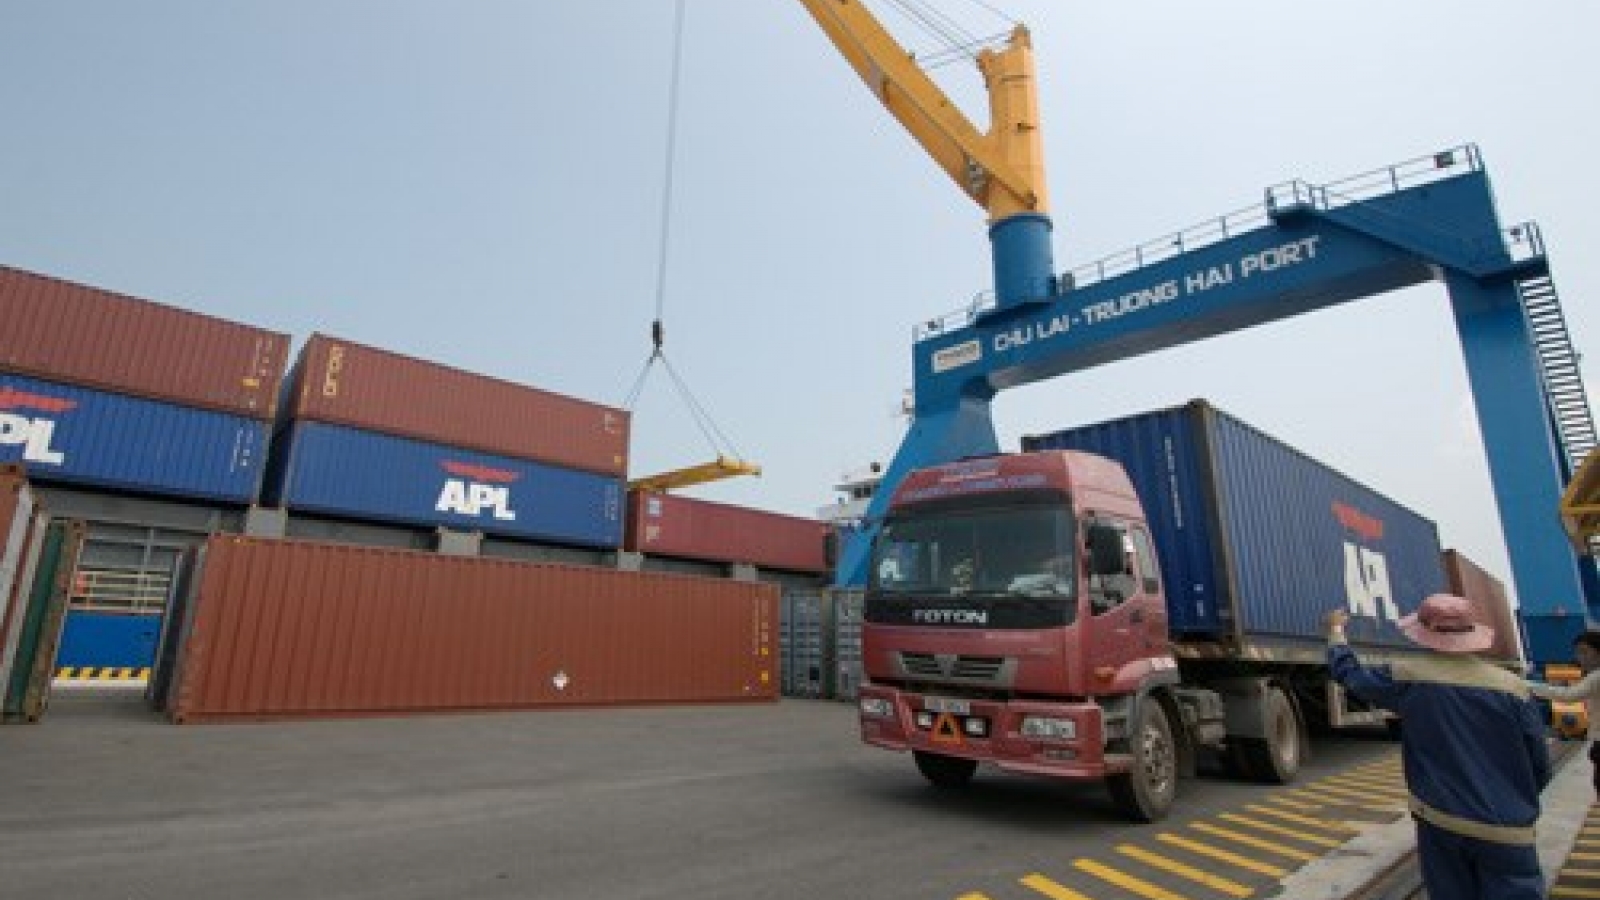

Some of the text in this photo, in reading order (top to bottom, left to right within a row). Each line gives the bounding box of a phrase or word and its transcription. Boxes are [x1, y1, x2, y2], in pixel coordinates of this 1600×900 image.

[994, 324, 1033, 351] CHU
[1036, 314, 1070, 339] LAI
[1184, 263, 1233, 296] HAI
[1241, 234, 1320, 278] PORT
[0, 411, 64, 466] PL
[435, 478, 516, 521] APL
[1343, 541, 1399, 621] APL
[912, 609, 987, 623] FOTON
